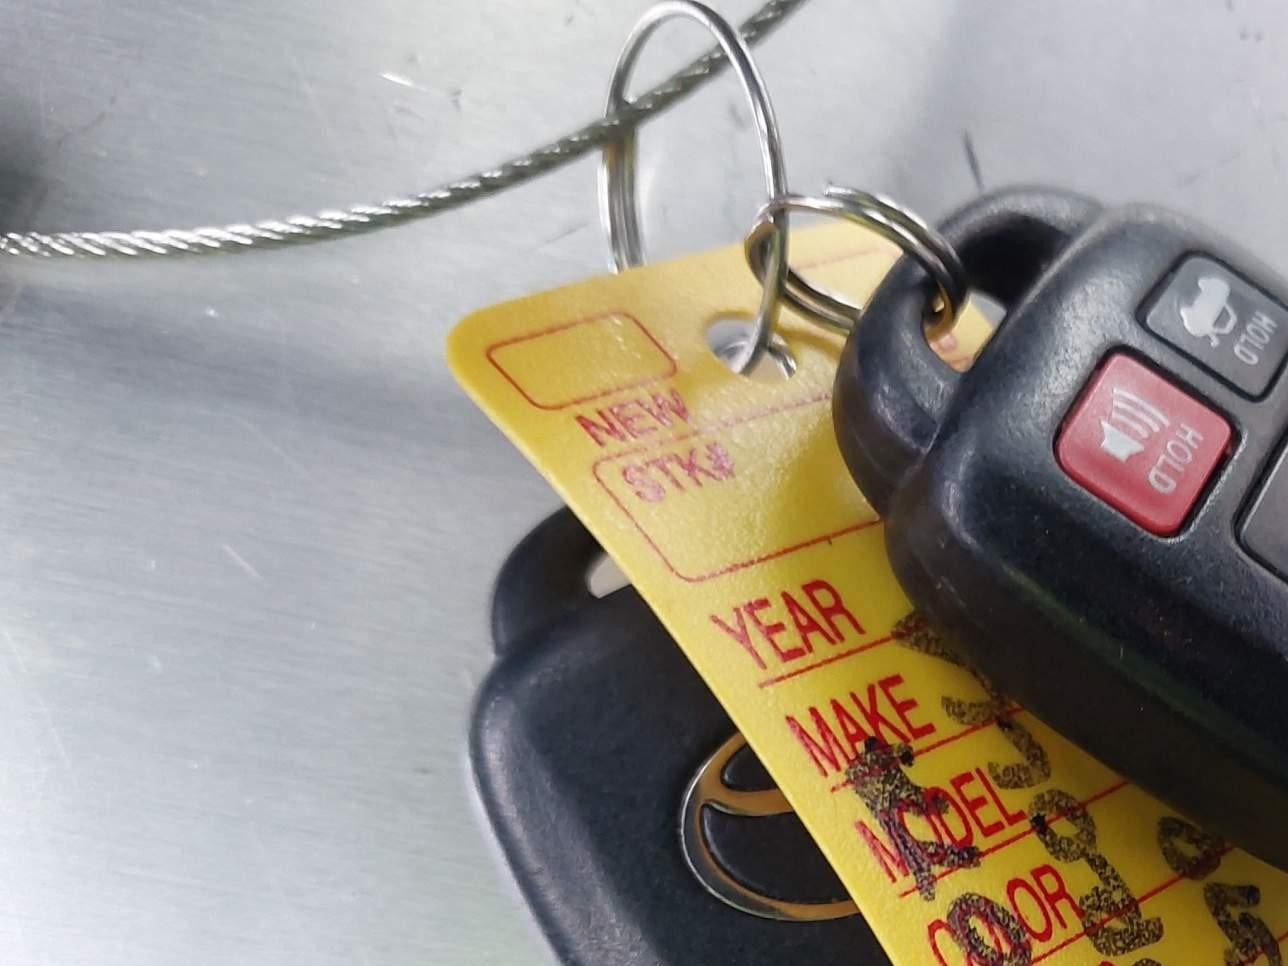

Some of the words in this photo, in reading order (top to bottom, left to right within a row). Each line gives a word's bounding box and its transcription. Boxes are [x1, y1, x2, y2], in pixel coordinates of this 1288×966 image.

[1233, 310, 1279, 366] HOLD
[575, 388, 690, 447] NEW
[1148, 422, 1203, 494] HOLD
[711, 579, 865, 670] YEAR
[785, 673, 937, 778] MAKE
[854, 768, 1028, 883] MODEL
